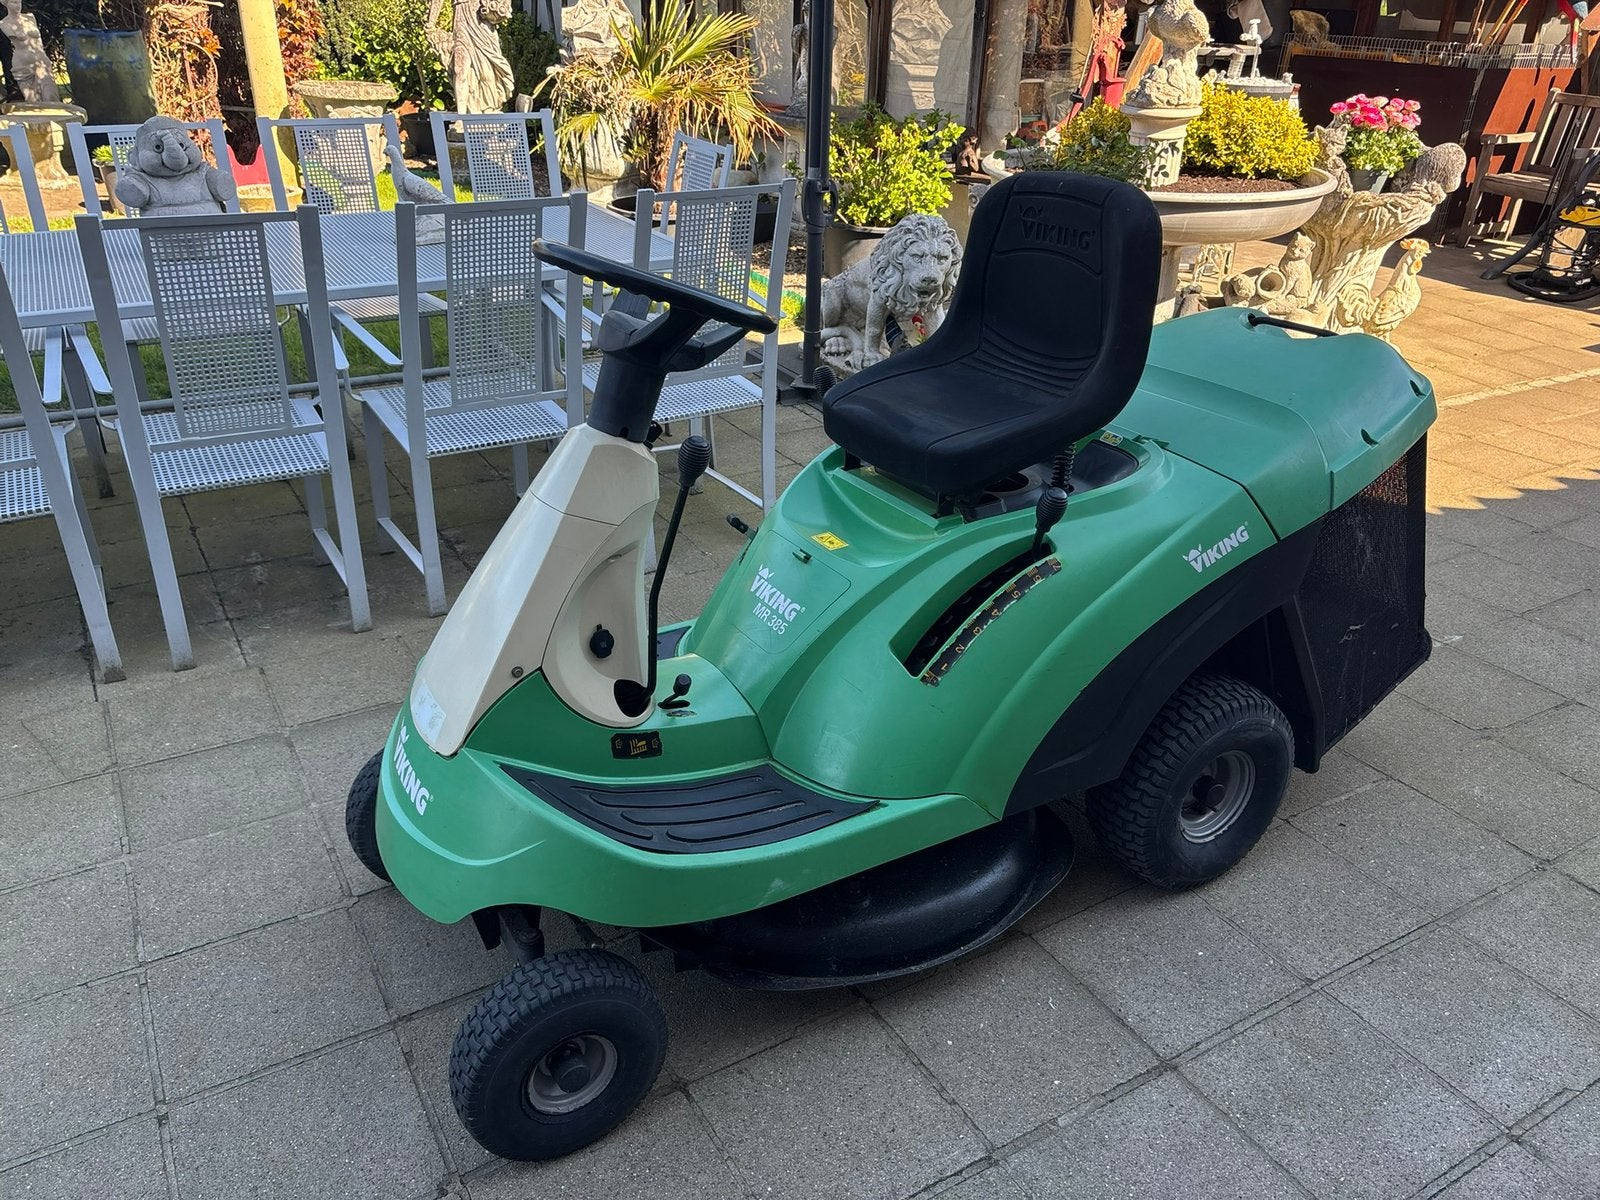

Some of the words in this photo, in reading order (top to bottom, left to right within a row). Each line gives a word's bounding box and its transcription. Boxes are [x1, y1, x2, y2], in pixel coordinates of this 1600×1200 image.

[1022, 220, 1091, 250] VIKING
[1189, 525, 1249, 573] VIKING
[750, 574, 801, 622] VIKING
[752, 603, 771, 622] MR
[767, 615, 788, 635] 385
[940, 662, 948, 671] 1
[955, 643, 965, 654] 2
[973, 626, 982, 636] 3
[991, 608, 1000, 617] 4
[1011, 590, 1021, 599] 5
[1033, 574, 1042, 583] 6
[393, 735, 430, 816] VIKING
